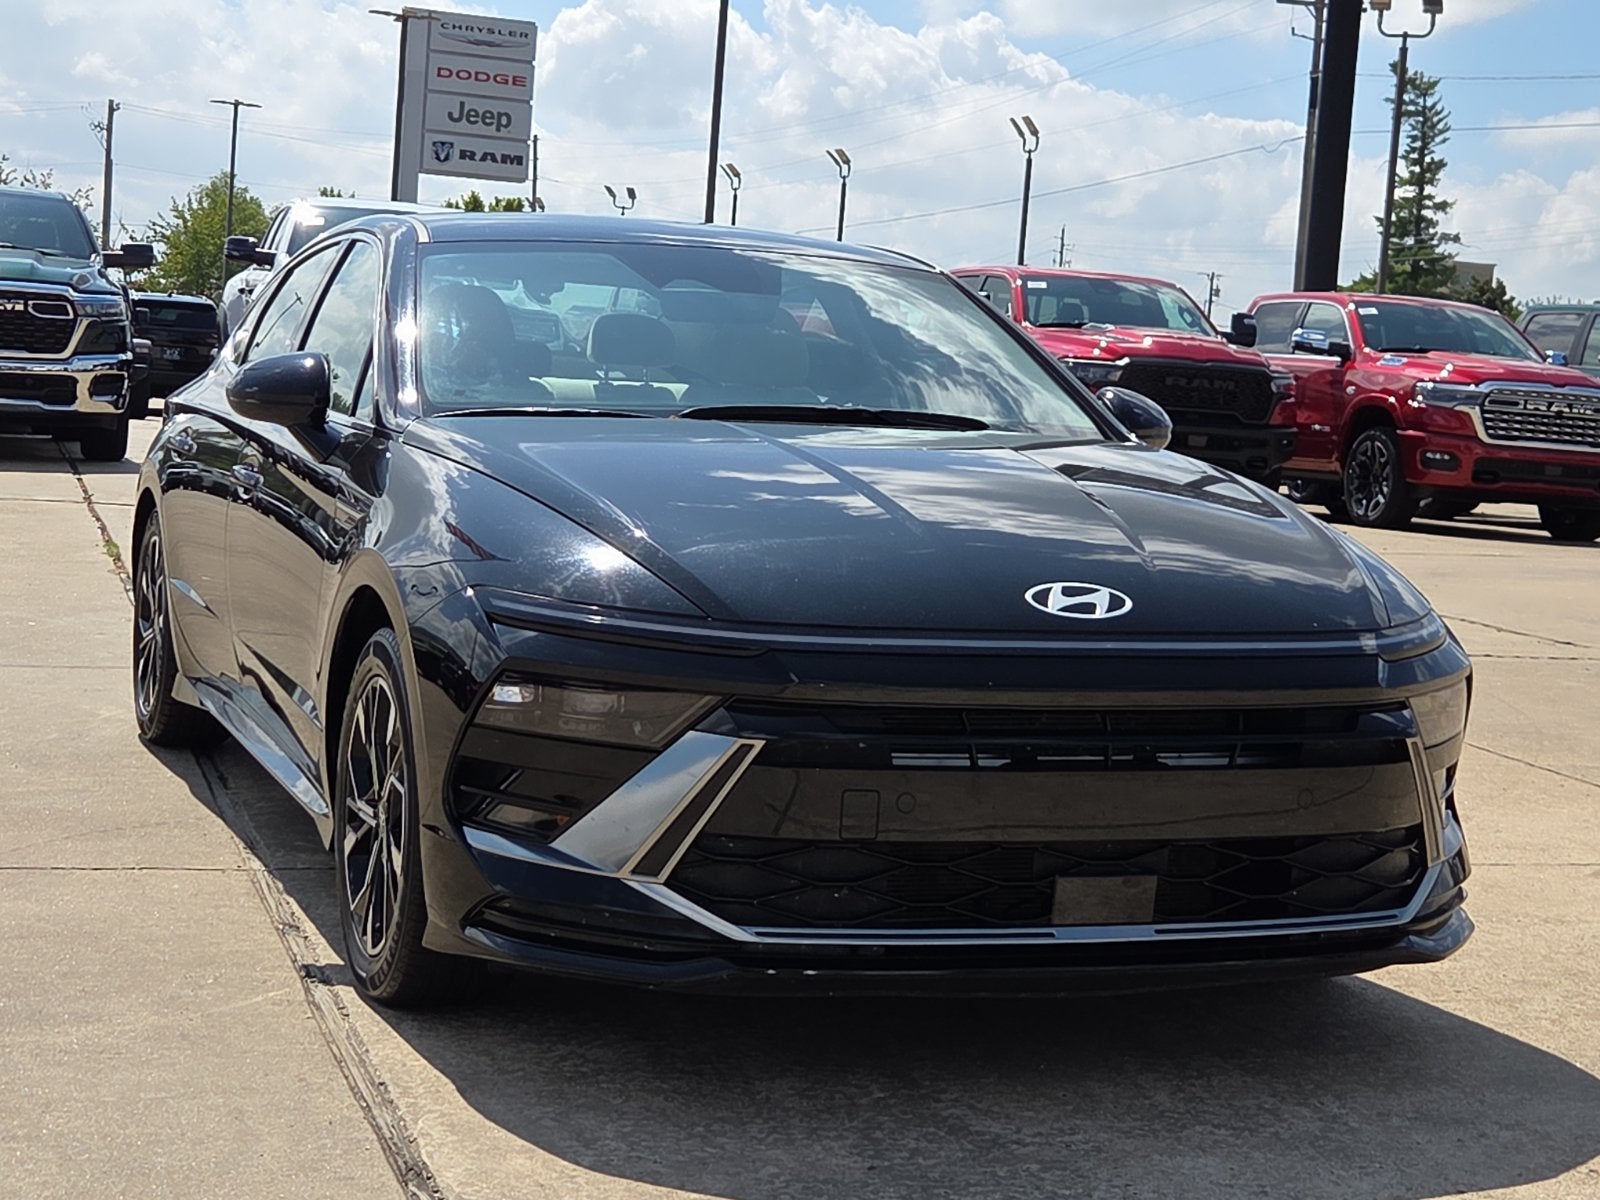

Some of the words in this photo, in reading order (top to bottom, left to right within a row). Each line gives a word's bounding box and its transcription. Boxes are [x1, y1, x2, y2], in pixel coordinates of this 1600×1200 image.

[440, 22, 529, 39] CHRYSLER
[436, 66, 527, 87] DODGE
[447, 101, 512, 132] Jeep
[458, 149, 524, 166] RAM
[1165, 376, 1236, 391] RAM
[1526, 400, 1595, 415] RAM
